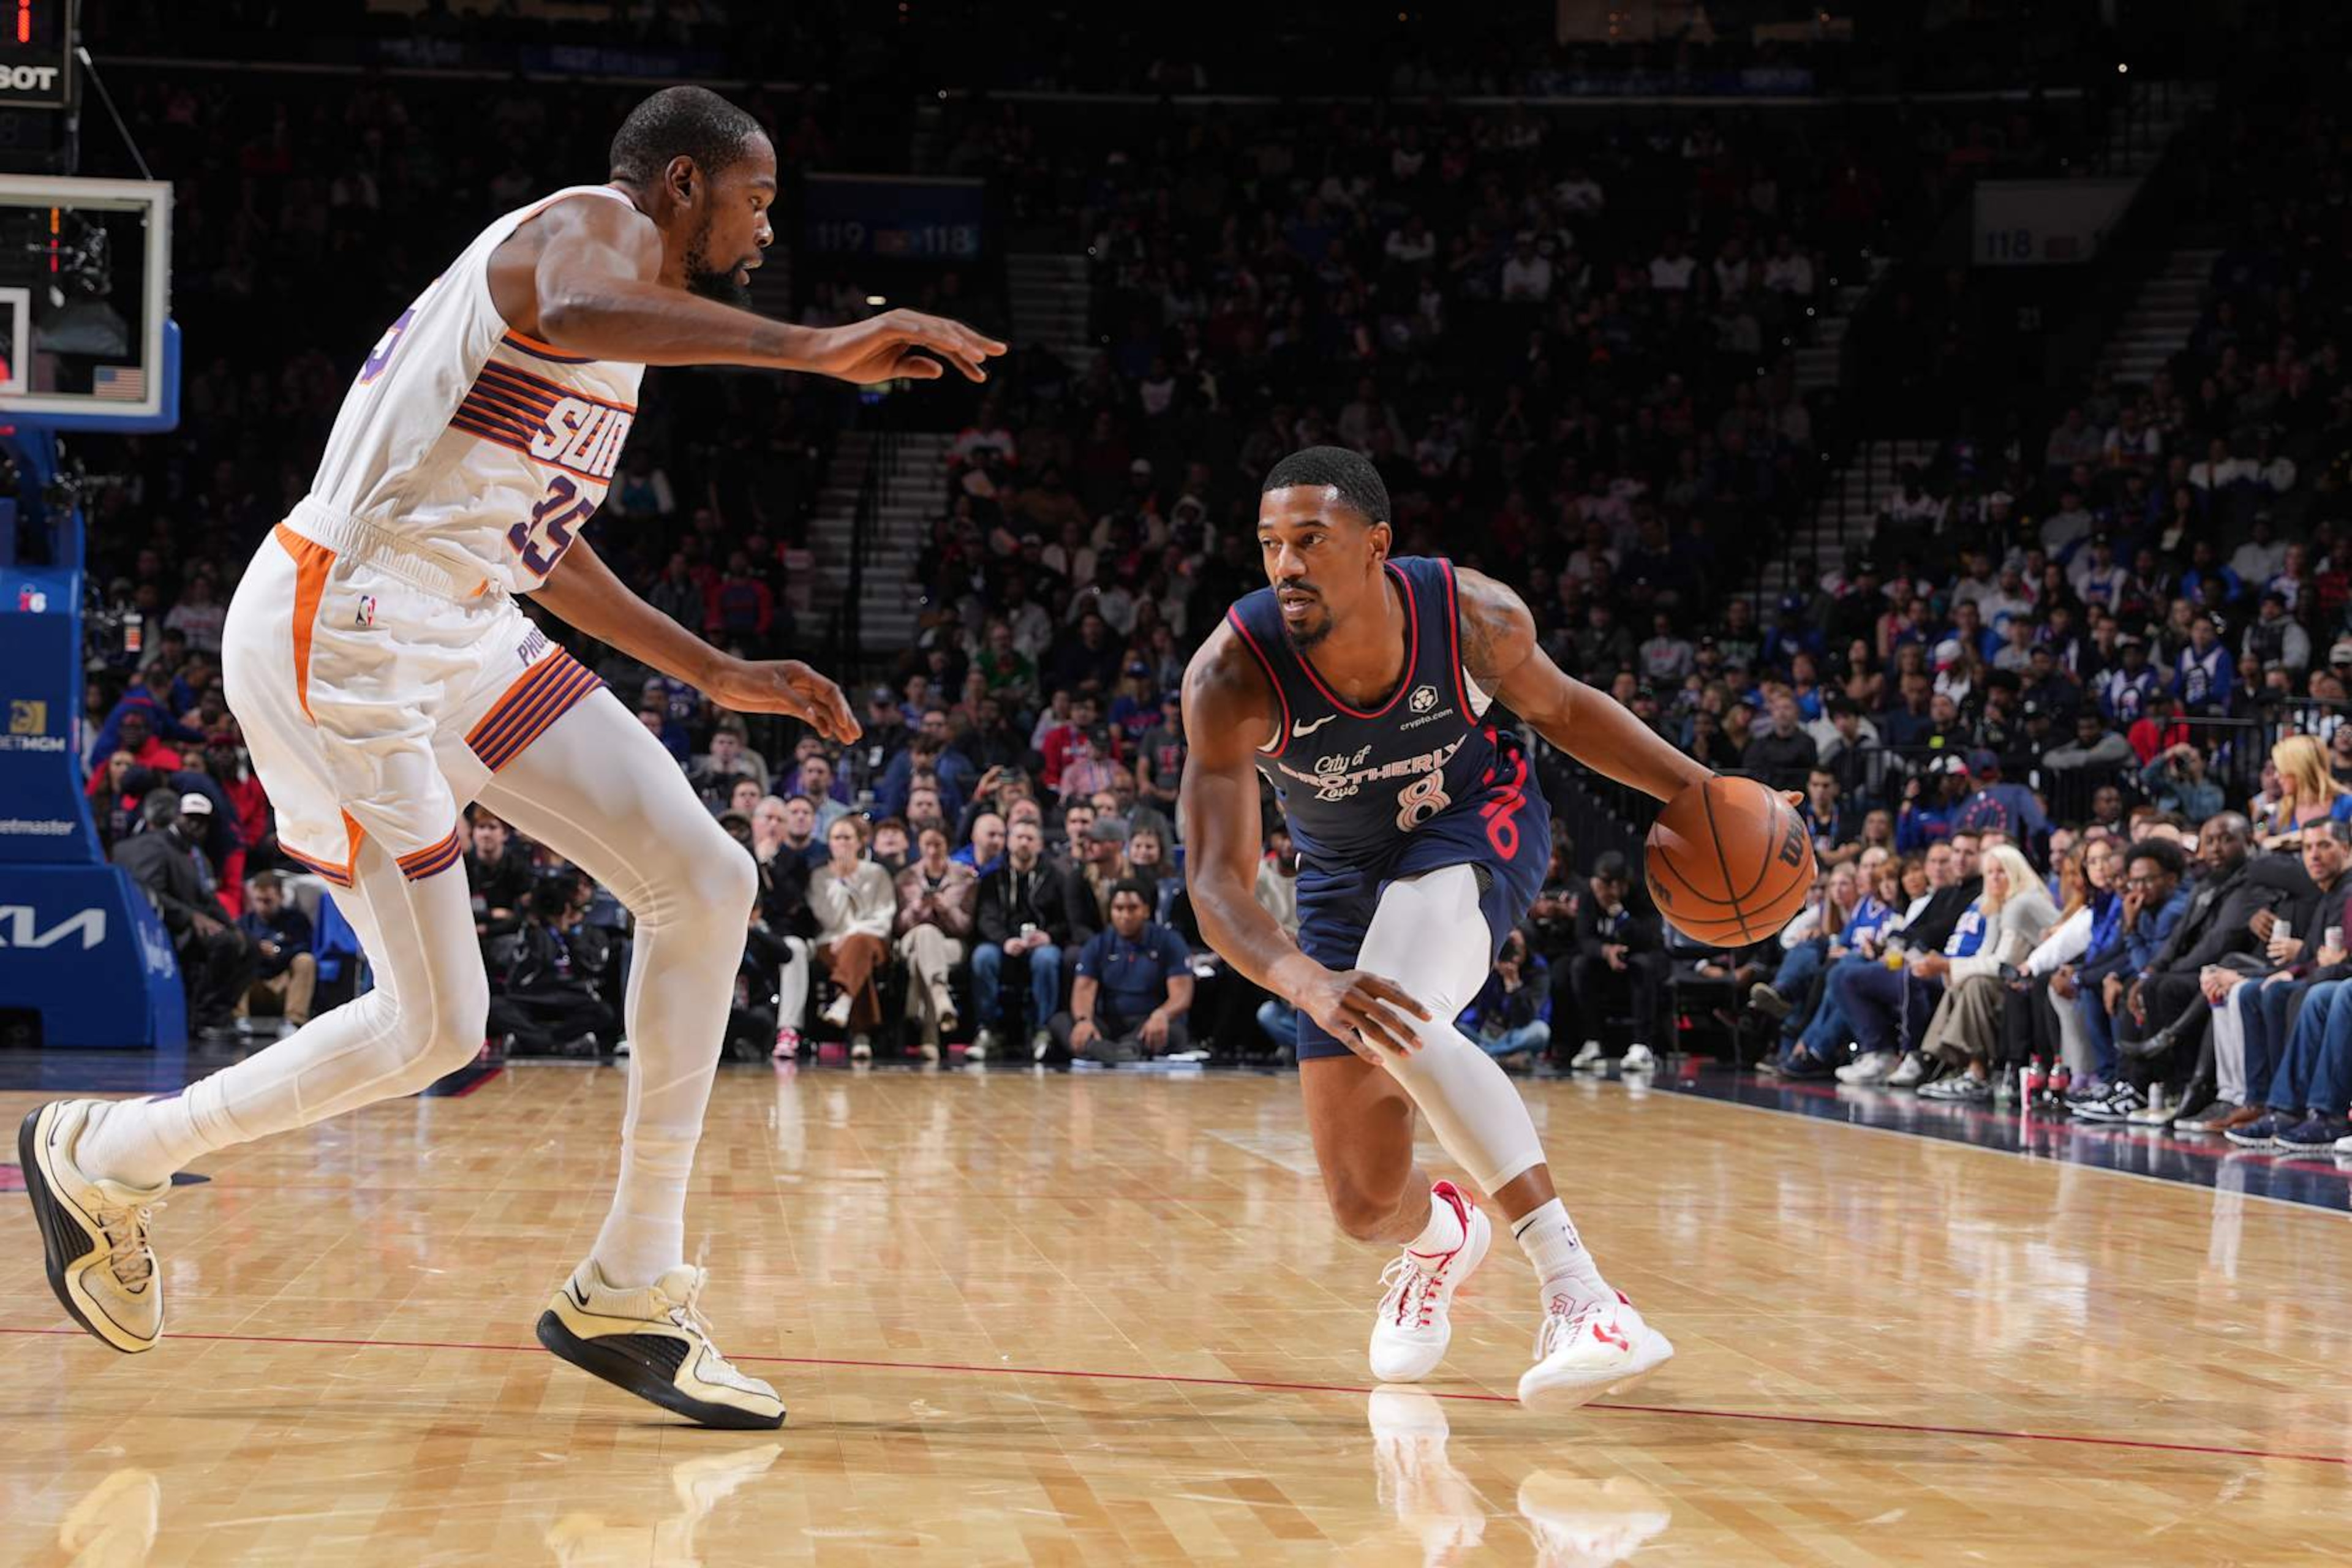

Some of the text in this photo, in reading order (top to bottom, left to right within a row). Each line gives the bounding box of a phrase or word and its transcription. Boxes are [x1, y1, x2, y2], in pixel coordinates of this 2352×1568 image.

[816, 221, 865, 250] 119
[920, 224, 970, 255] 118
[1988, 230, 2031, 258] 118
[503, 475, 595, 578] 35
[1400, 708, 1454, 731] crypto.com
[1314, 744, 1372, 776] City of
[1314, 785, 1359, 802] Love
[1396, 768, 1452, 833] 8
